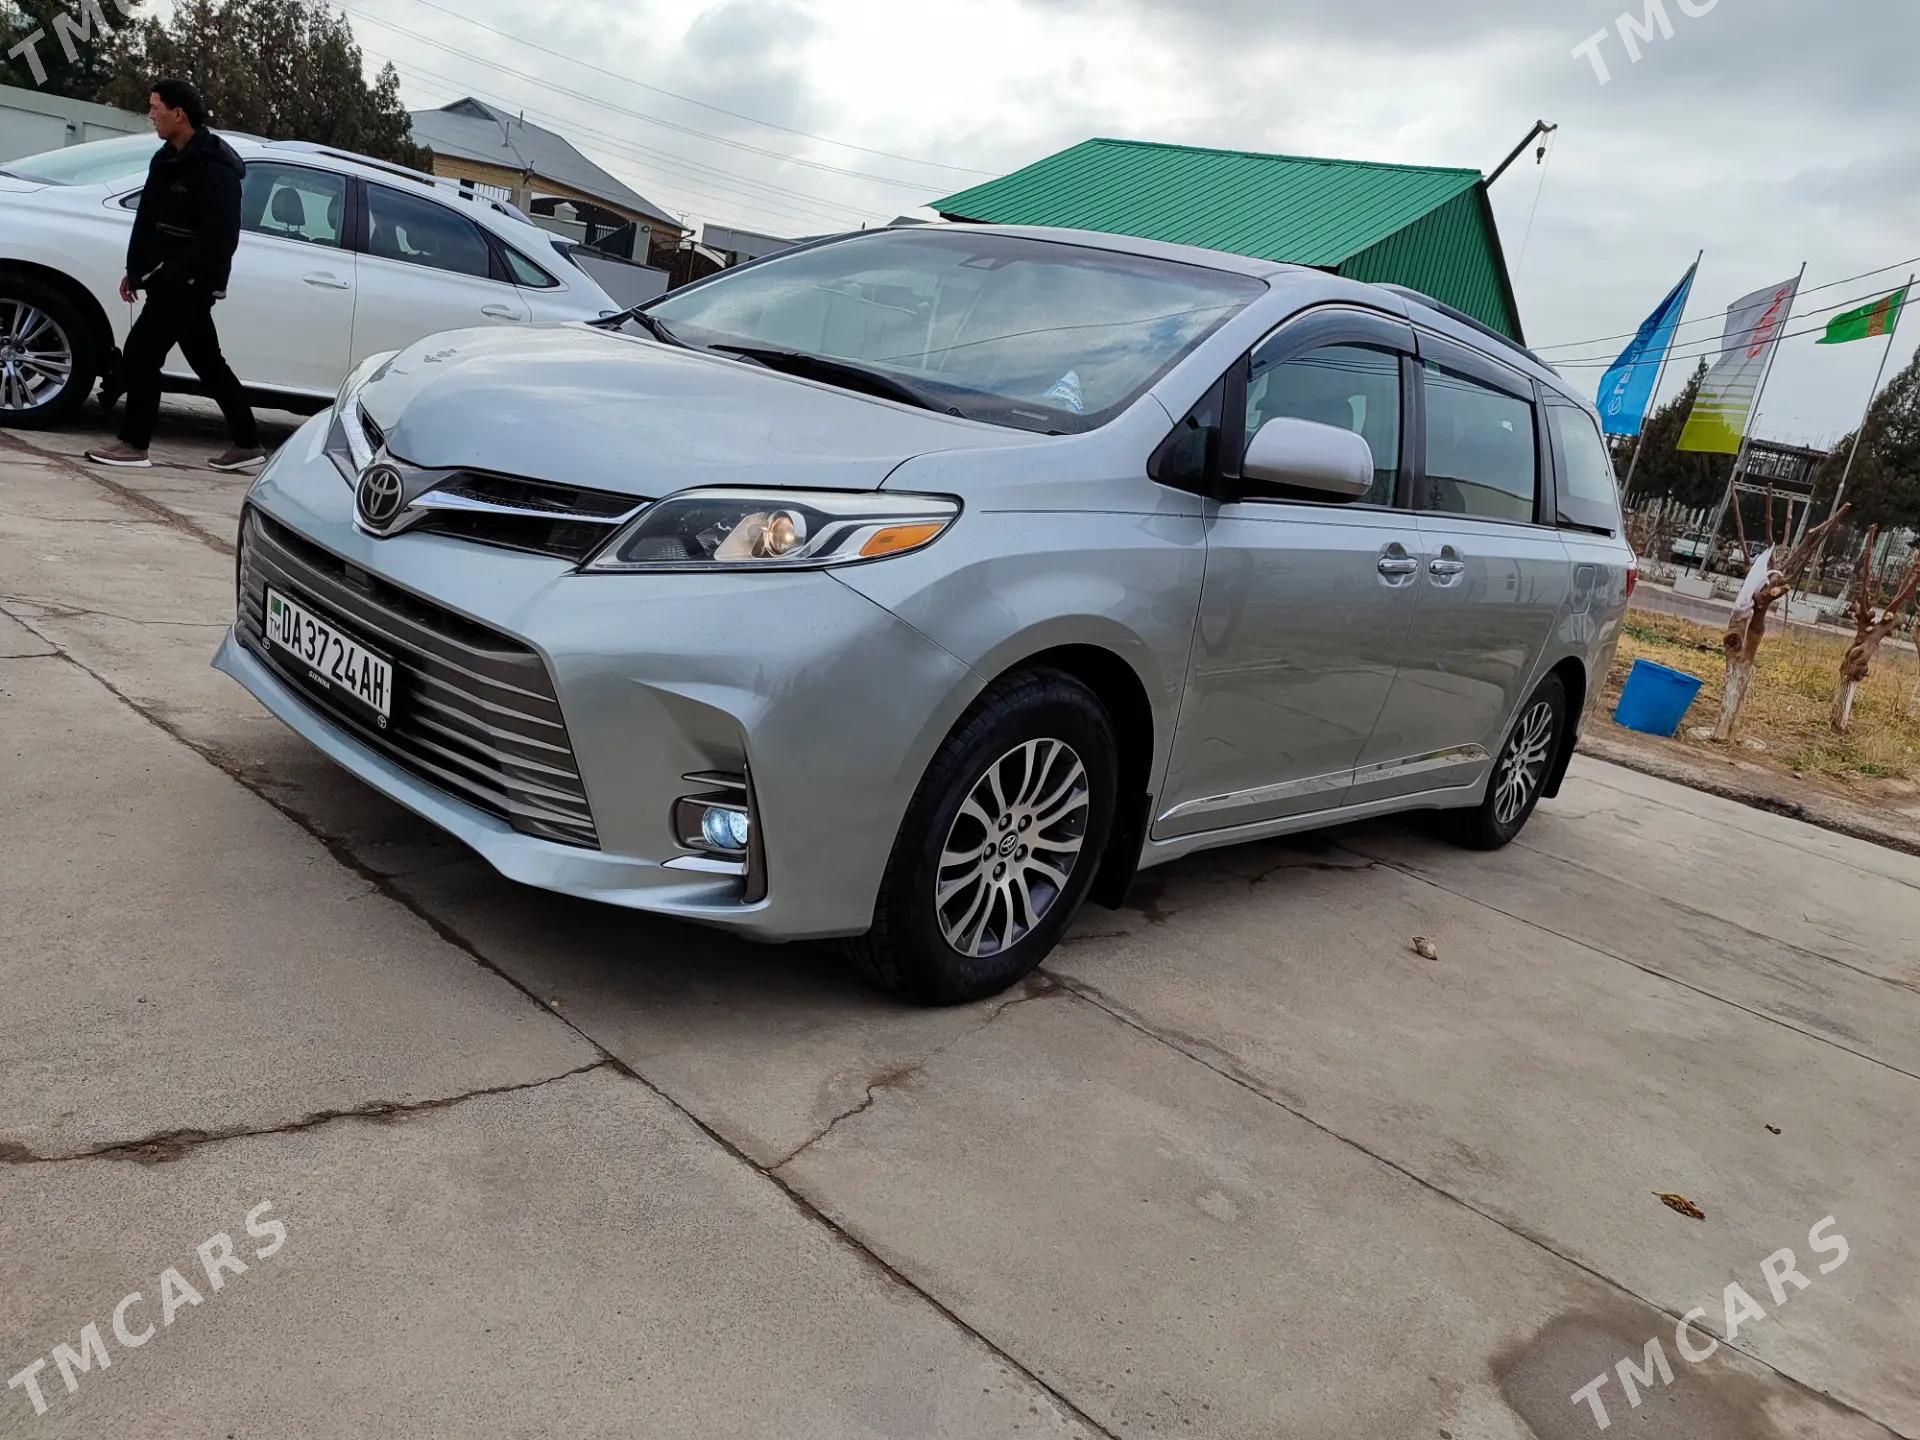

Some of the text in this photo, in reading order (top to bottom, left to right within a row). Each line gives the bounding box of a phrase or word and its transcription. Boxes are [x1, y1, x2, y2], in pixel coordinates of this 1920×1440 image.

[270, 616, 281, 639] TM
[282, 602, 385, 710] DA3724AH
[308, 670, 330, 690] SIENNA
